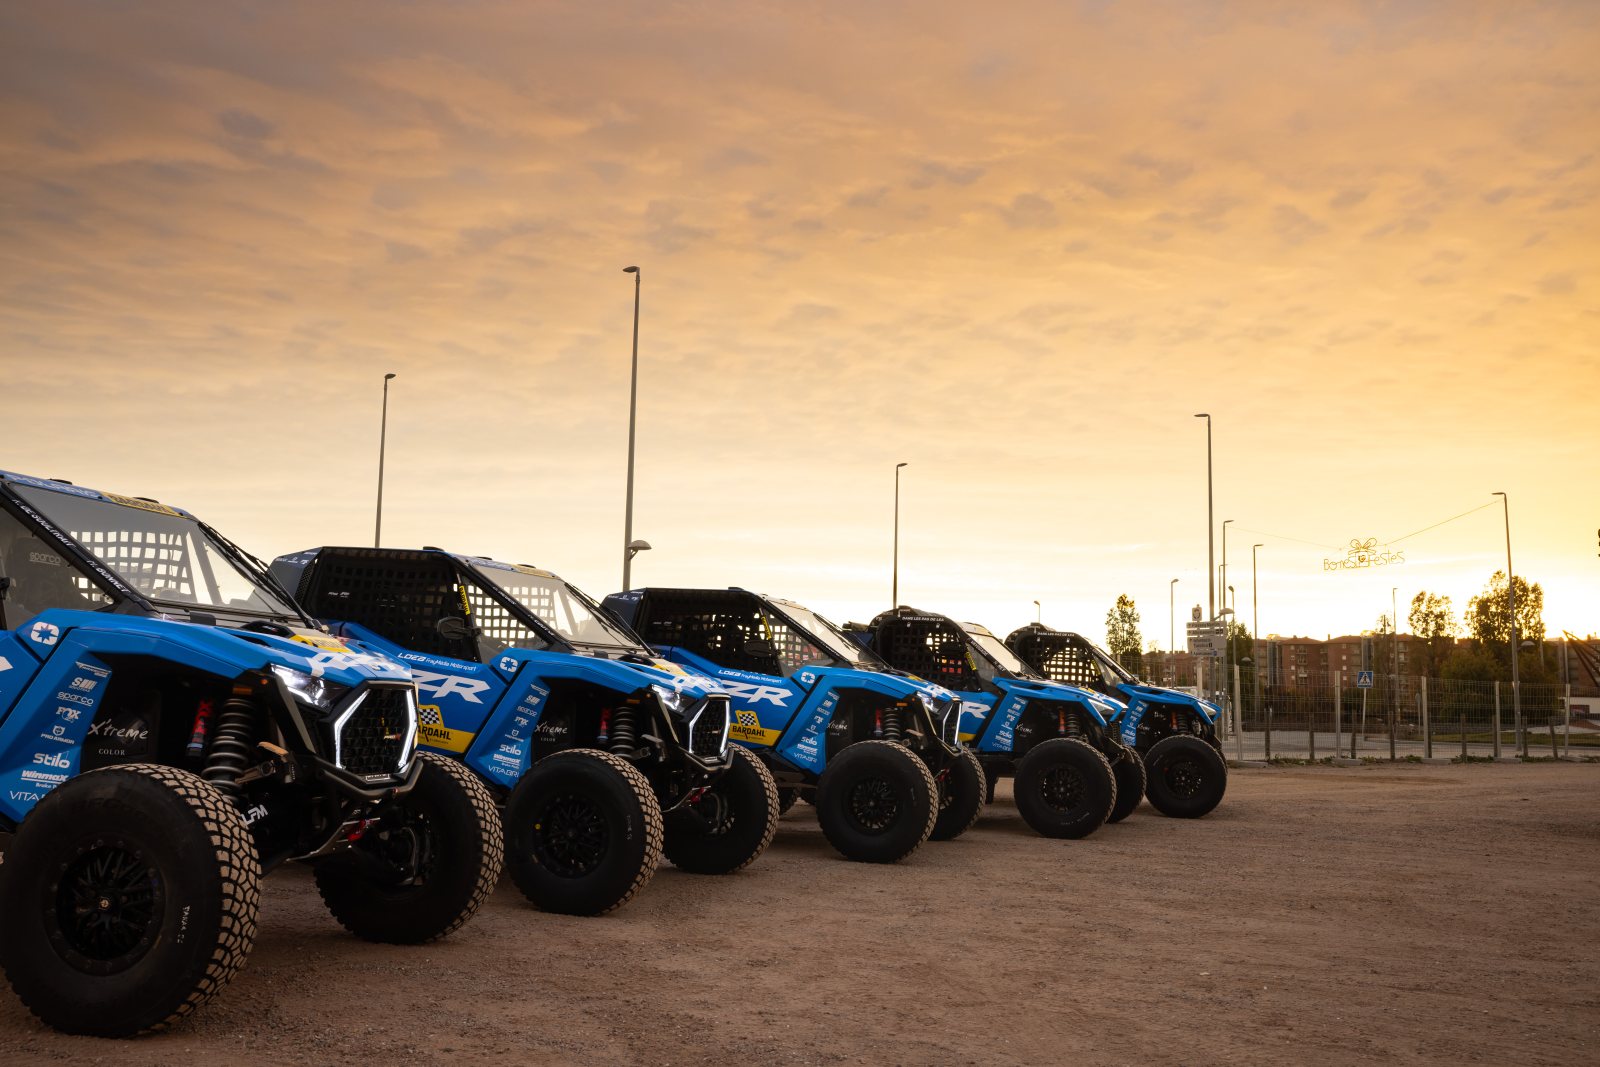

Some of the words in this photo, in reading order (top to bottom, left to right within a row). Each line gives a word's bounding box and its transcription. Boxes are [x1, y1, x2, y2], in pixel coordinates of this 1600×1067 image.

[449, 662, 477, 672] Motorsport
[411, 668, 491, 705] ZR
[720, 679, 794, 708] ZR
[56, 691, 94, 706] sparco
[56, 706, 82, 720] FOX
[731, 725, 767, 740] BARDAHL
[98, 748, 126, 756] COLOR
[499, 744, 522, 756] Stilo
[33, 751, 71, 769] Stilo
[21, 770, 70, 782] Winmax
[10, 790, 46, 802] VITA
